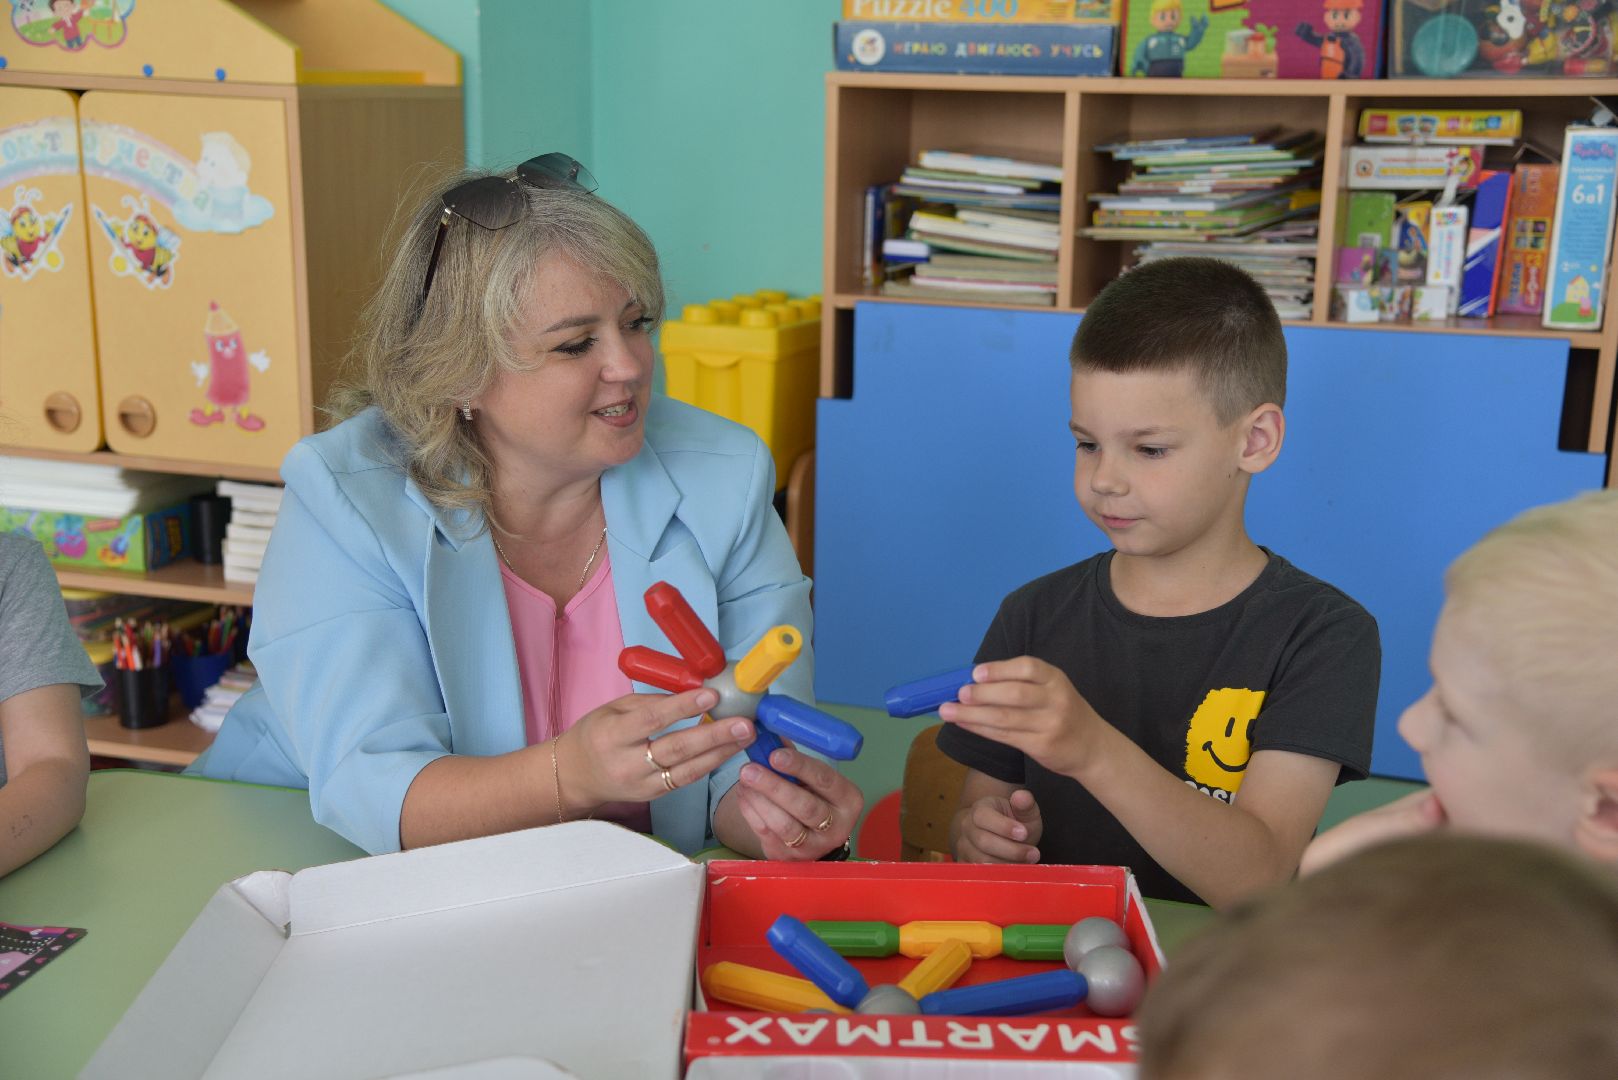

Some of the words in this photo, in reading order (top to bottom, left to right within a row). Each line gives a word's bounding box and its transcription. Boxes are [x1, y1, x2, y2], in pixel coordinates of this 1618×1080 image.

[960, 0, 1018, 18] 400
[893, 42, 947, 57] ИГРАЮ
[1050, 43, 1104, 59] УЧУСЬ
